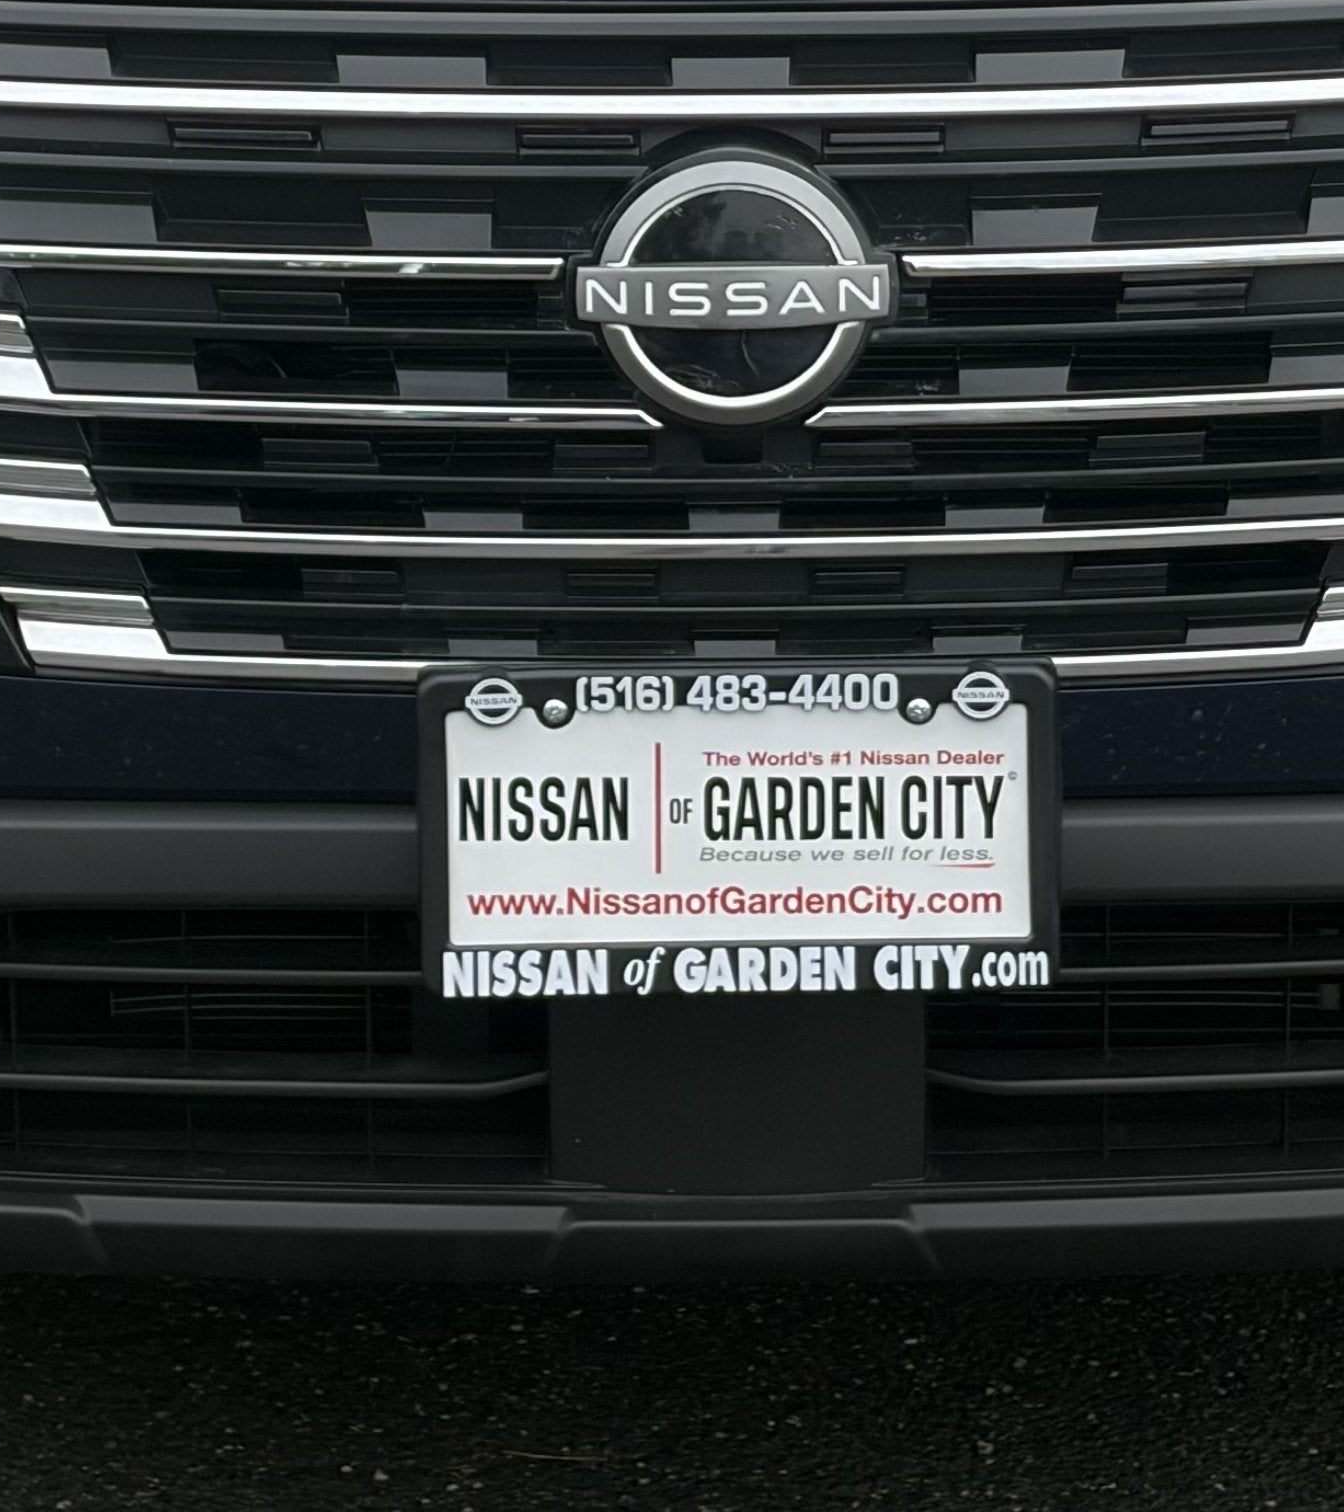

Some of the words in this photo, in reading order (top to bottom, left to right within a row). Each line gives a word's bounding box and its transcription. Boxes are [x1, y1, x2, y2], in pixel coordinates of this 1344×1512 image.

[585, 275, 881, 317] NISSAN
[469, 696, 519, 706] NISSAN
[575, 675, 675, 713] (516)
[686, 672, 900, 712] 483-4400
[956, 690, 1006, 701] NISSAN
[702, 751, 741, 766] The
[748, 751, 824, 766] World's
[830, 751, 852, 766] #1
[860, 750, 930, 766] Nissan
[936, 750, 1005, 765] Dealer
[458, 777, 629, 842] NISSAN
[669, 798, 693, 825] OF
[704, 776, 885, 842] GARDEN
[901, 775, 1005, 841] CITY
[699, 846, 802, 862] Because
[811, 849, 845, 861] we
[853, 846, 894, 862] sell
[902, 846, 934, 862] for
[940, 846, 994, 861] less.
[467, 886, 1002, 920] www.NissanofGardenCity.com
[443, 949, 609, 998] NISSAN
[623, 946, 666, 995] of
[673, 946, 856, 994] GARDEN
